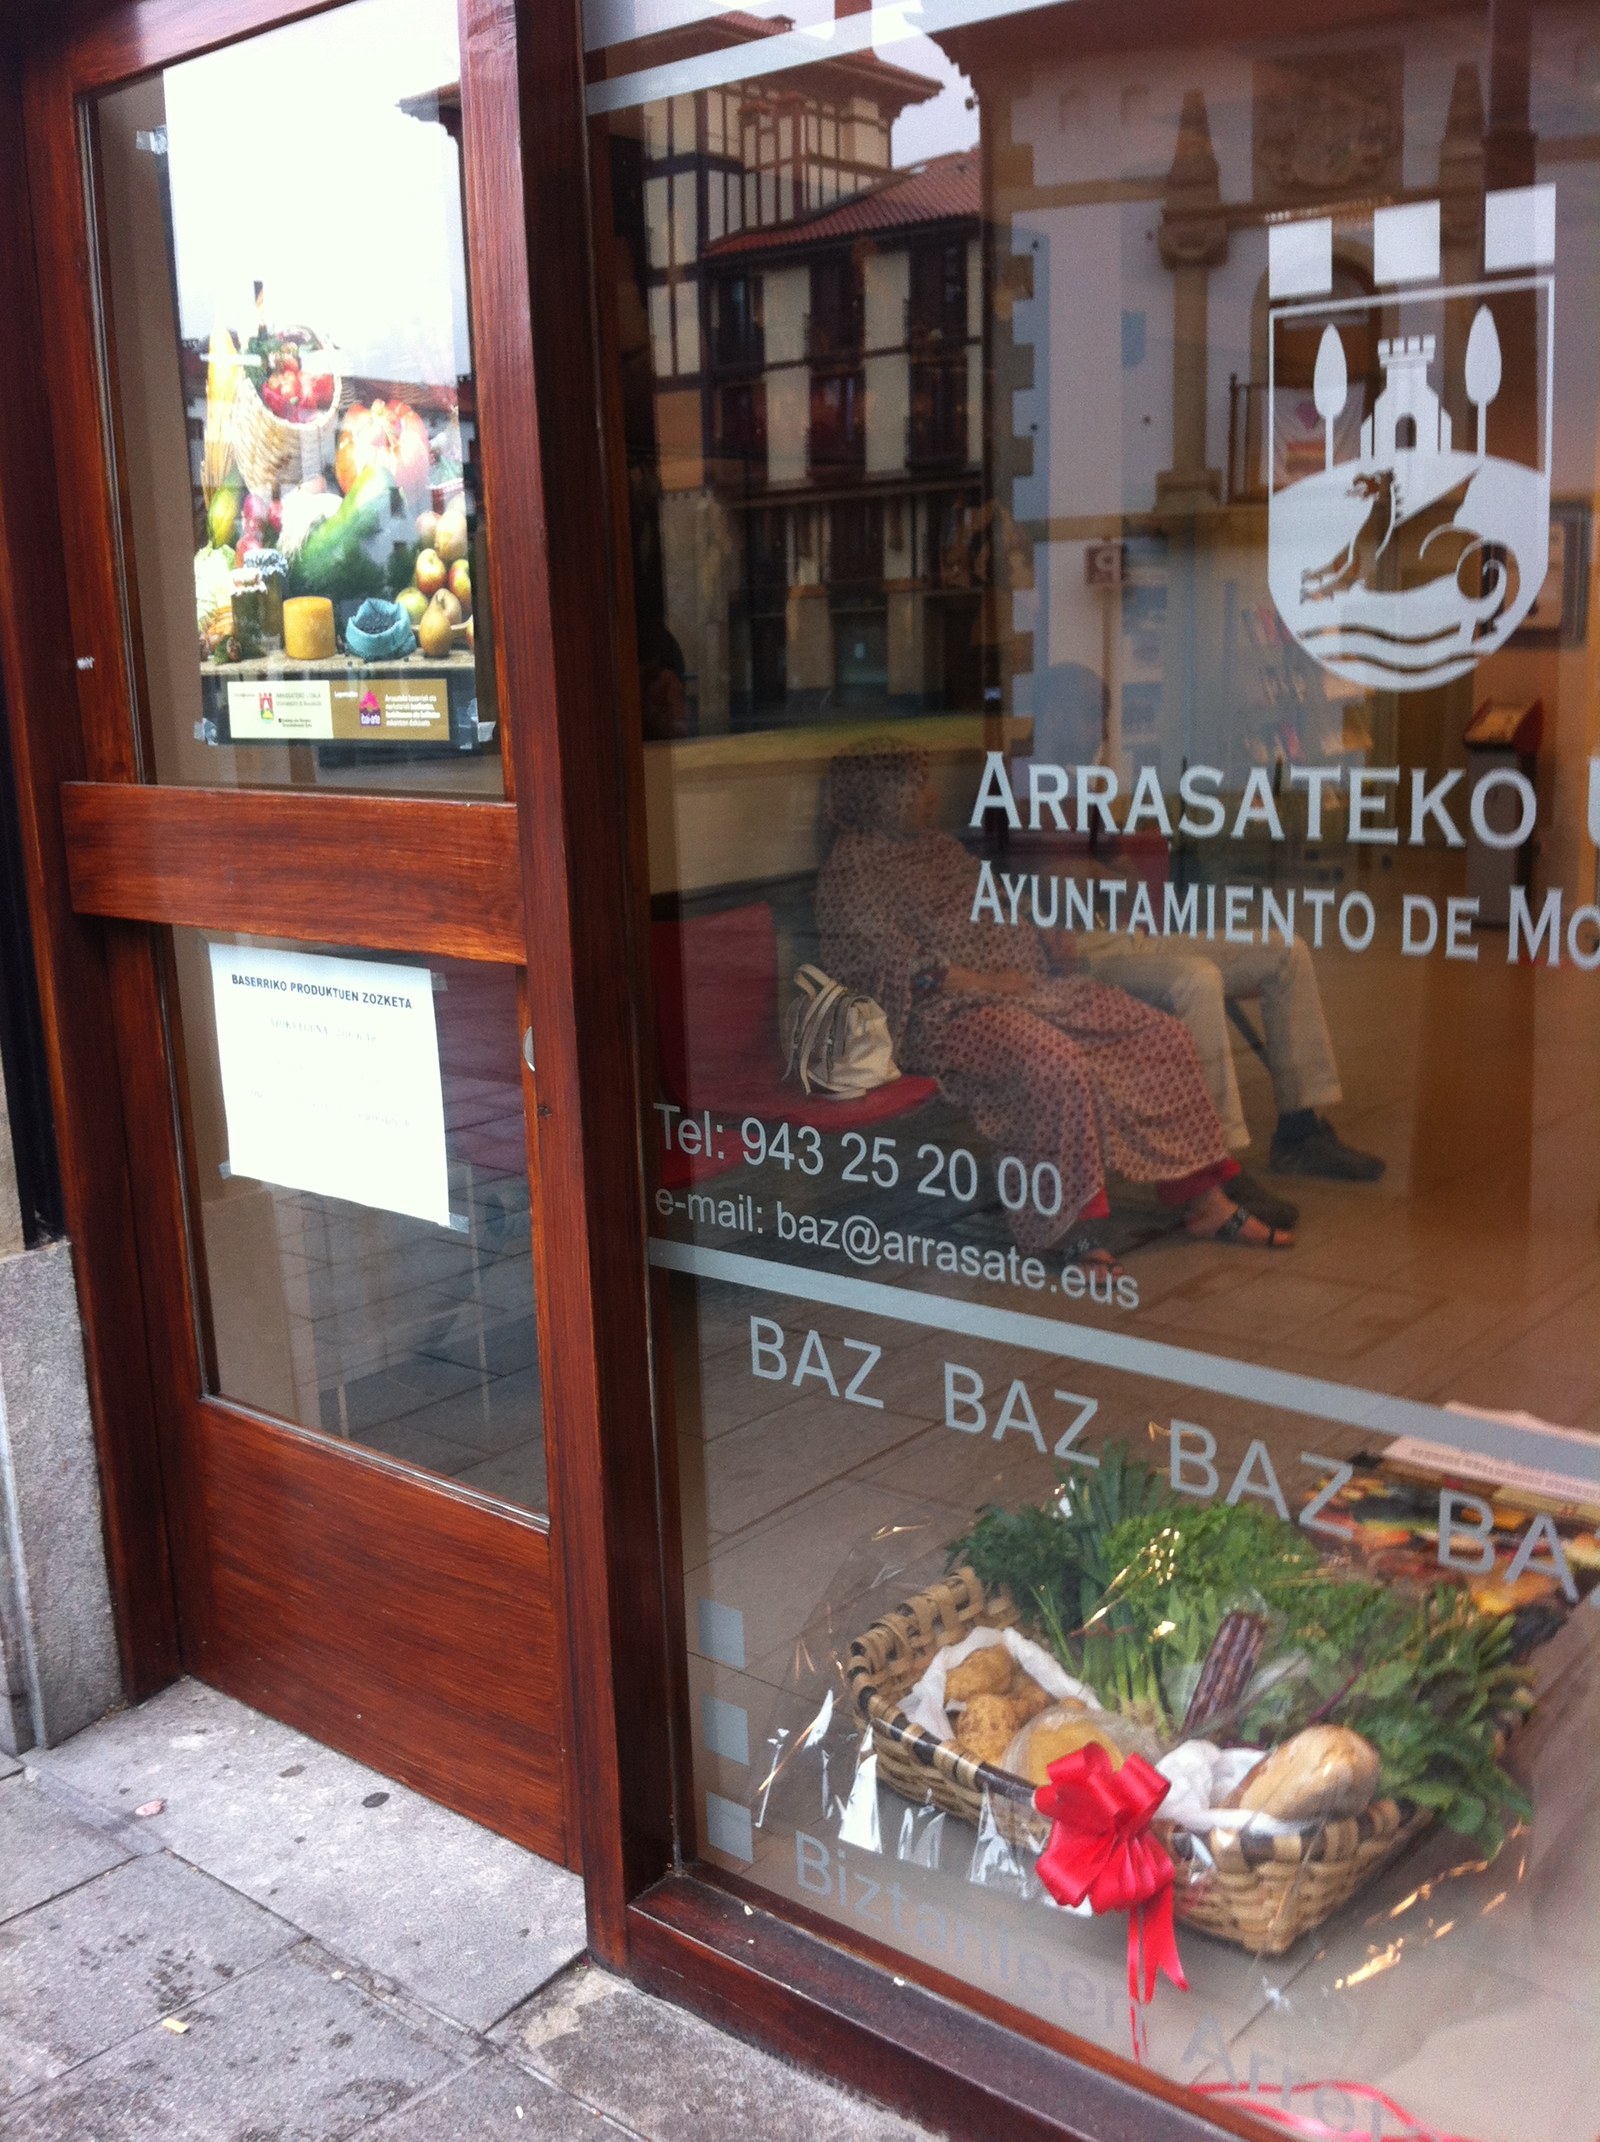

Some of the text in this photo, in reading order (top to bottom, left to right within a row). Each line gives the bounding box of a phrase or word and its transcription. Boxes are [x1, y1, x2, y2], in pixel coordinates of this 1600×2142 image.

[968, 751, 1538, 850] ARRASATEKO
[970, 860, 1376, 952] AYUNTAMIENTO
[1401, 895, 1481, 962] DE
[231, 974, 412, 1009] BASERRIKO PRODUKTUEN ZOZKETA
[652, 1102, 1063, 1217] Tel: 943 25 20 00
[655, 1188, 1141, 1311] e-mail: baz@arrasate.eus
[749, 1314, 885, 1410] BAZ
[944, 1362, 1100, 1468] BAZ
[1169, 1418, 1355, 1541] BAZ
